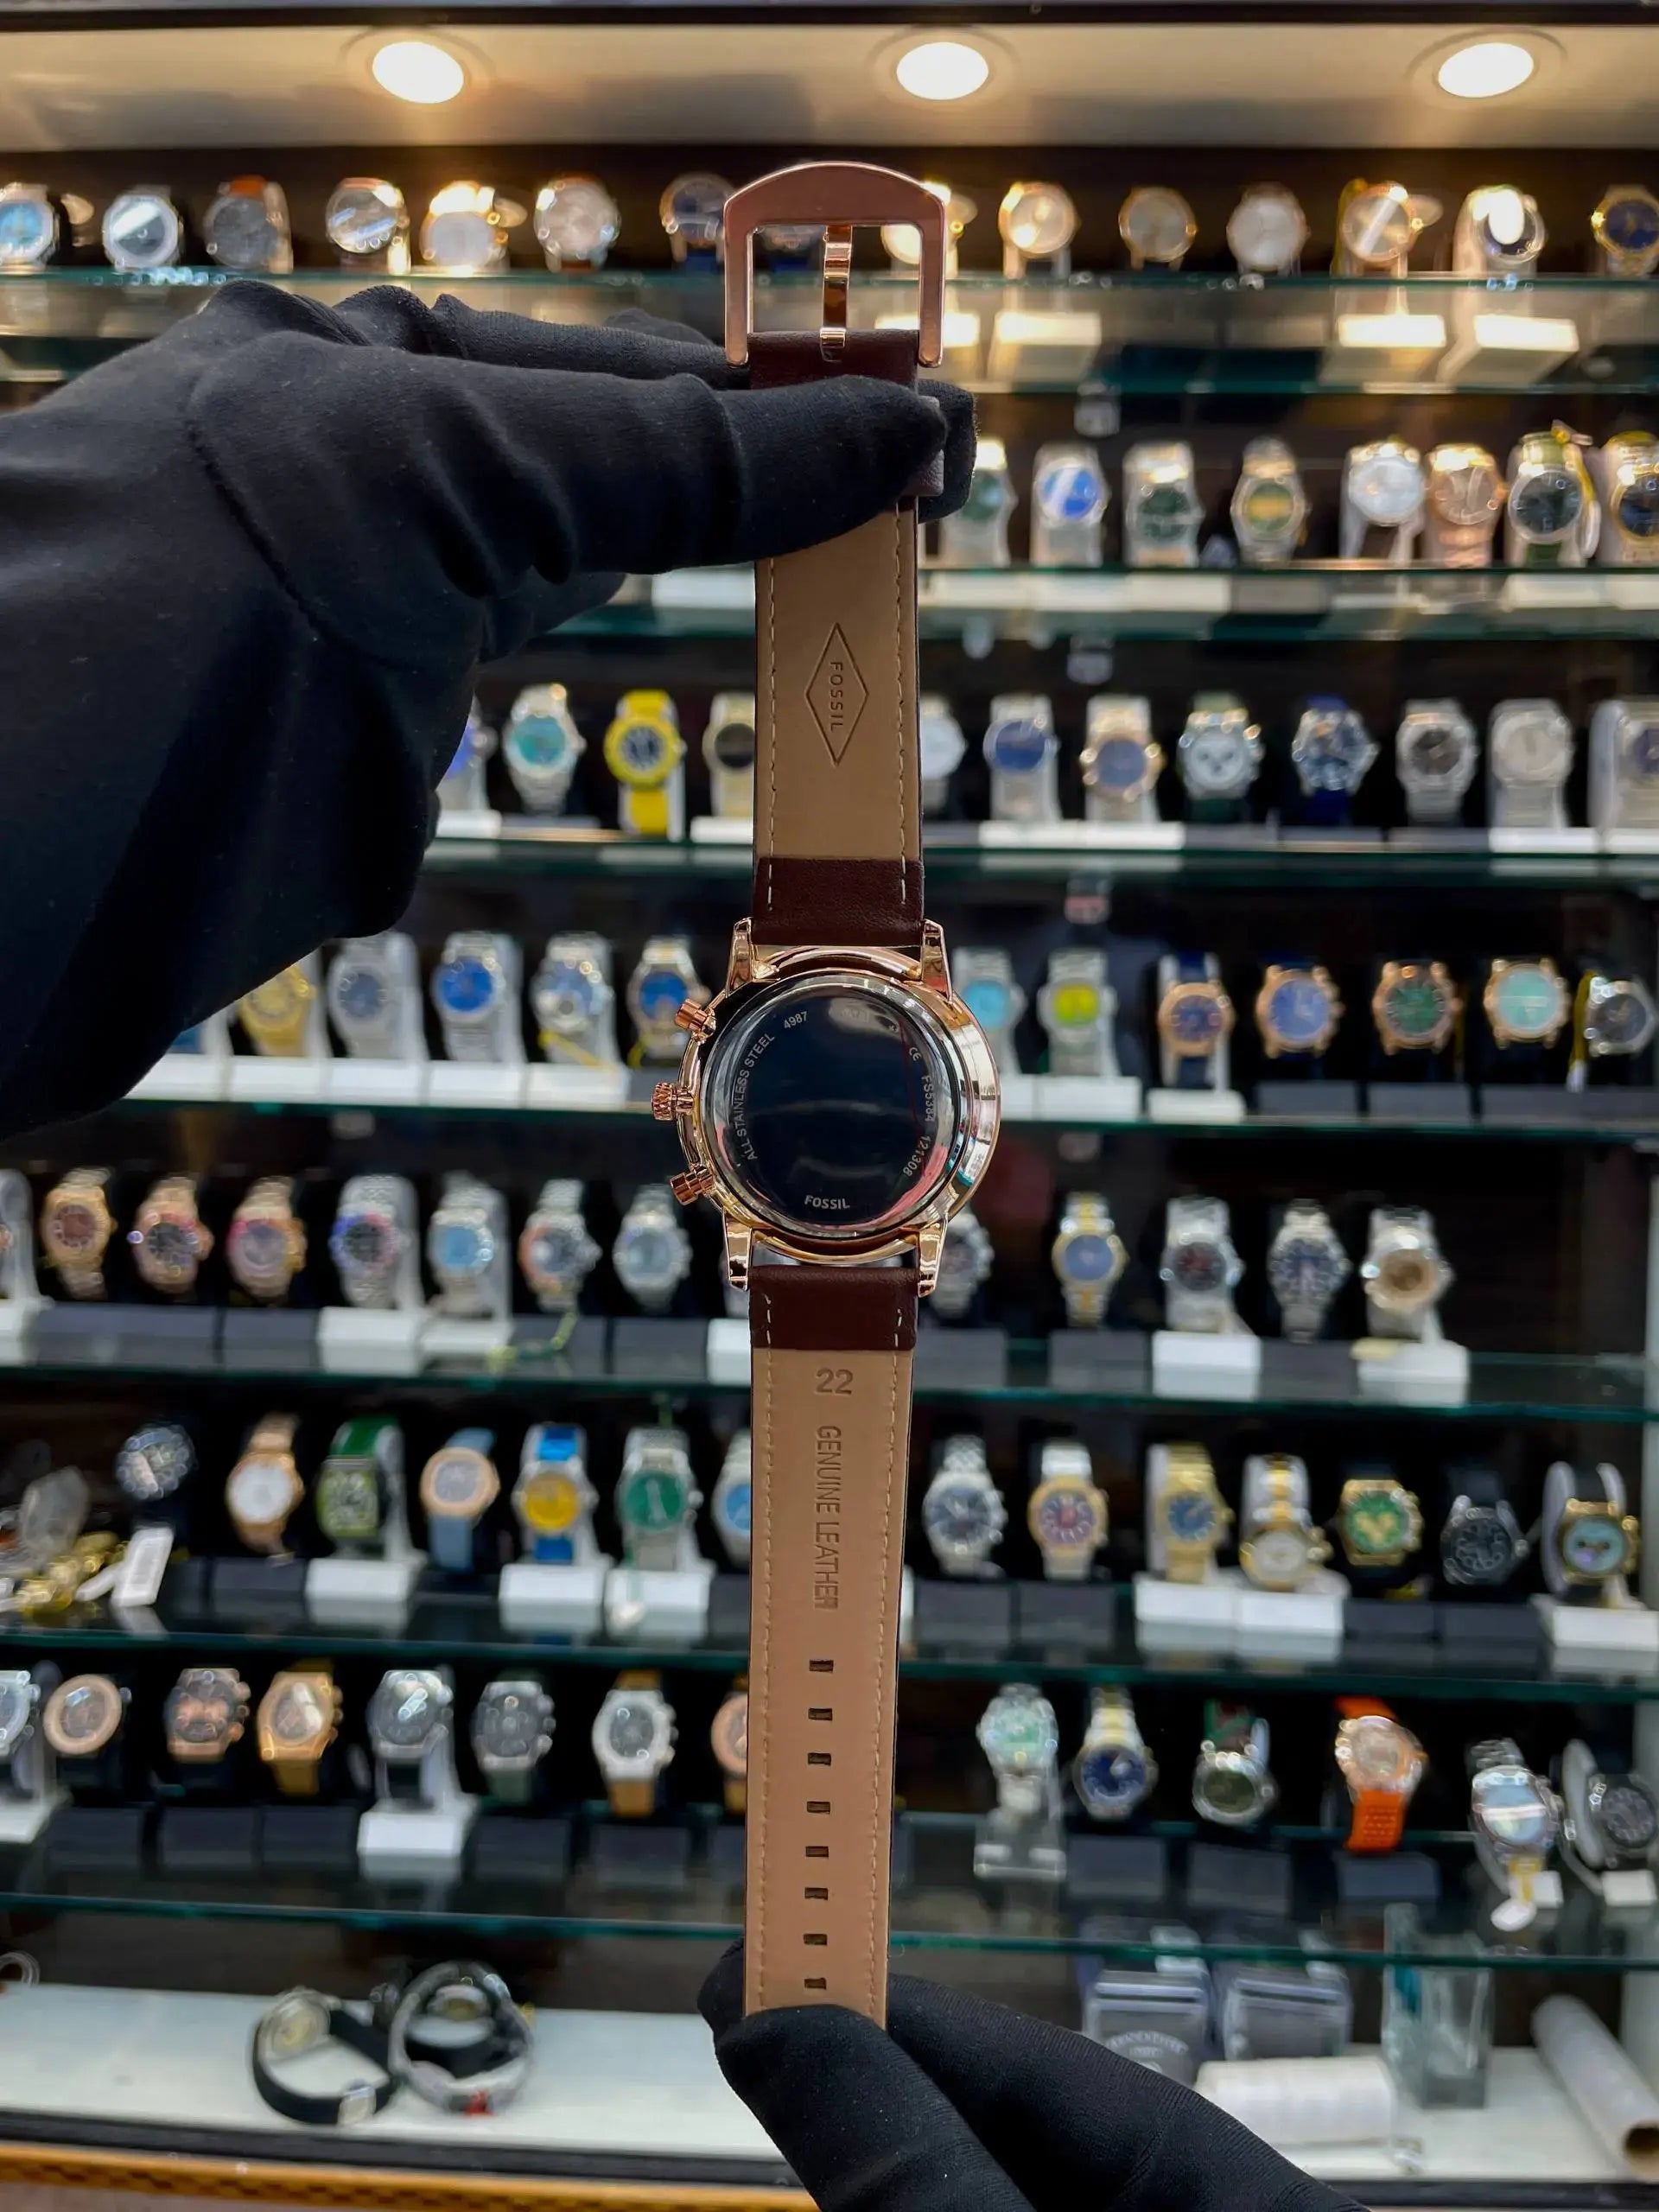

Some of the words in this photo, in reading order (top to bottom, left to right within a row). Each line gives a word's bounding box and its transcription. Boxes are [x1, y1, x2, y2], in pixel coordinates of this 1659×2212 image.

[830, 660, 843, 733] FOSSIL
[783, 1010, 808, 1030] 4987
[744, 1033, 775, 1068] STEEL
[734, 1069, 750, 1137] STAINLESS
[921, 1075, 934, 1122] FS5384
[741, 1138, 759, 1160] ALL
[903, 1135, 931, 1176] 121308
[804, 1194, 851, 1210] FOSSIL
[816, 1368, 854, 1395] 22
[816, 1426, 842, 1513] GENUINE
[814, 1522, 840, 1609] LEATHER
